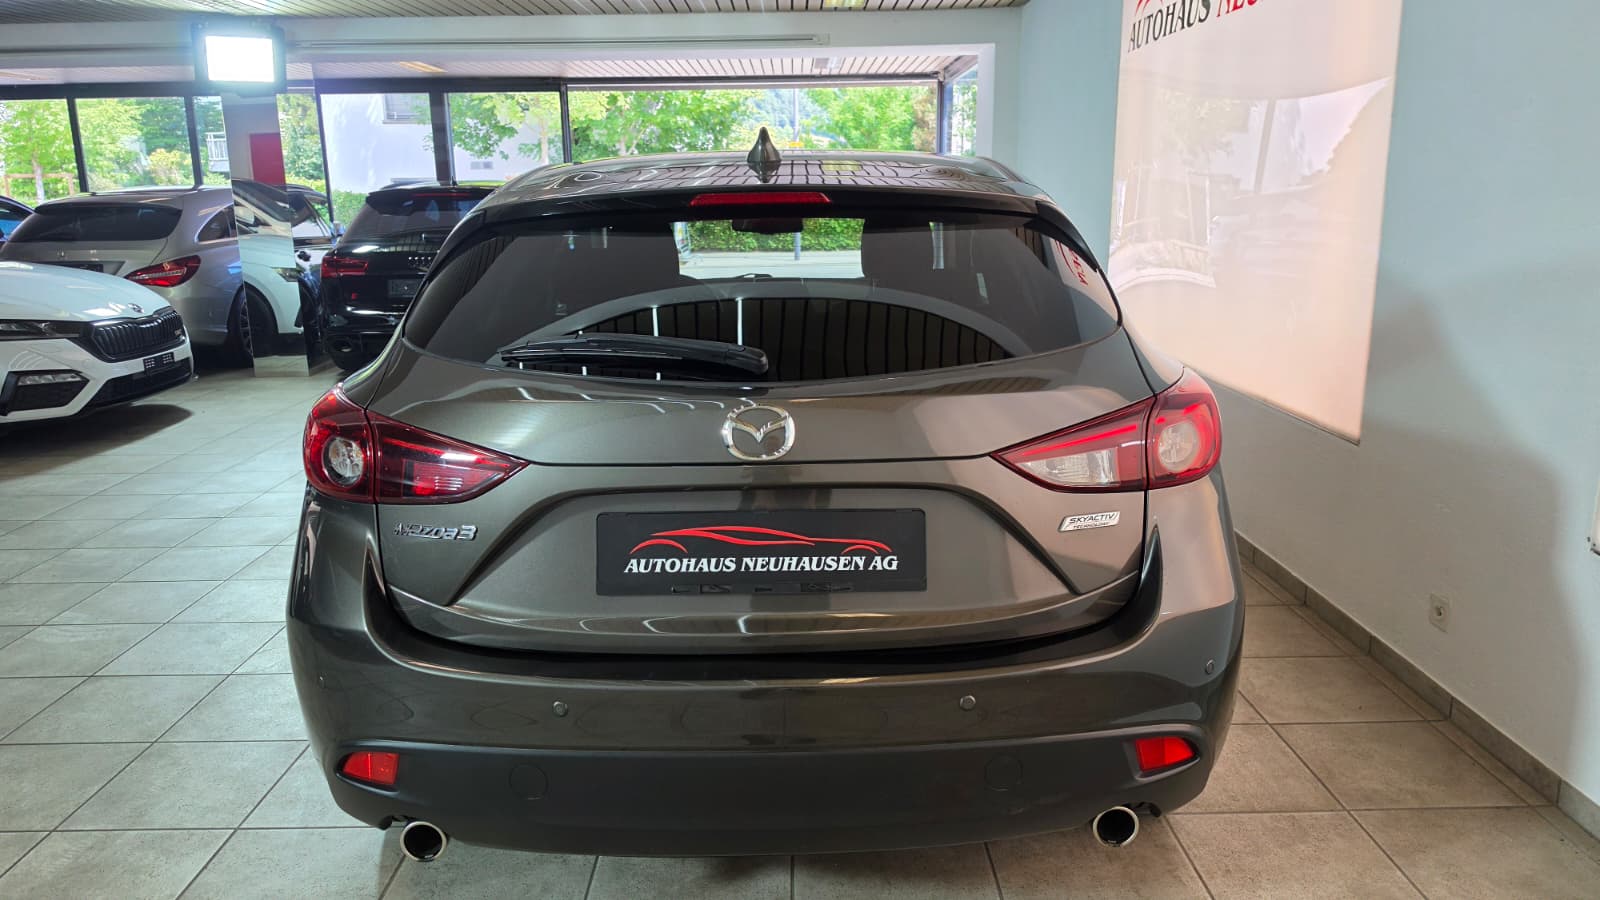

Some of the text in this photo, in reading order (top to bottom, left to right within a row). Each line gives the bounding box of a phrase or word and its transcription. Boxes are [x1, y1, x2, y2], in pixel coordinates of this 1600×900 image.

[1127, 0, 1211, 53] AUTOHAUS
[1068, 513, 1115, 524] SKYACTIV
[624, 555, 899, 573] AUTOHAUS NEUHAUSEN AG
